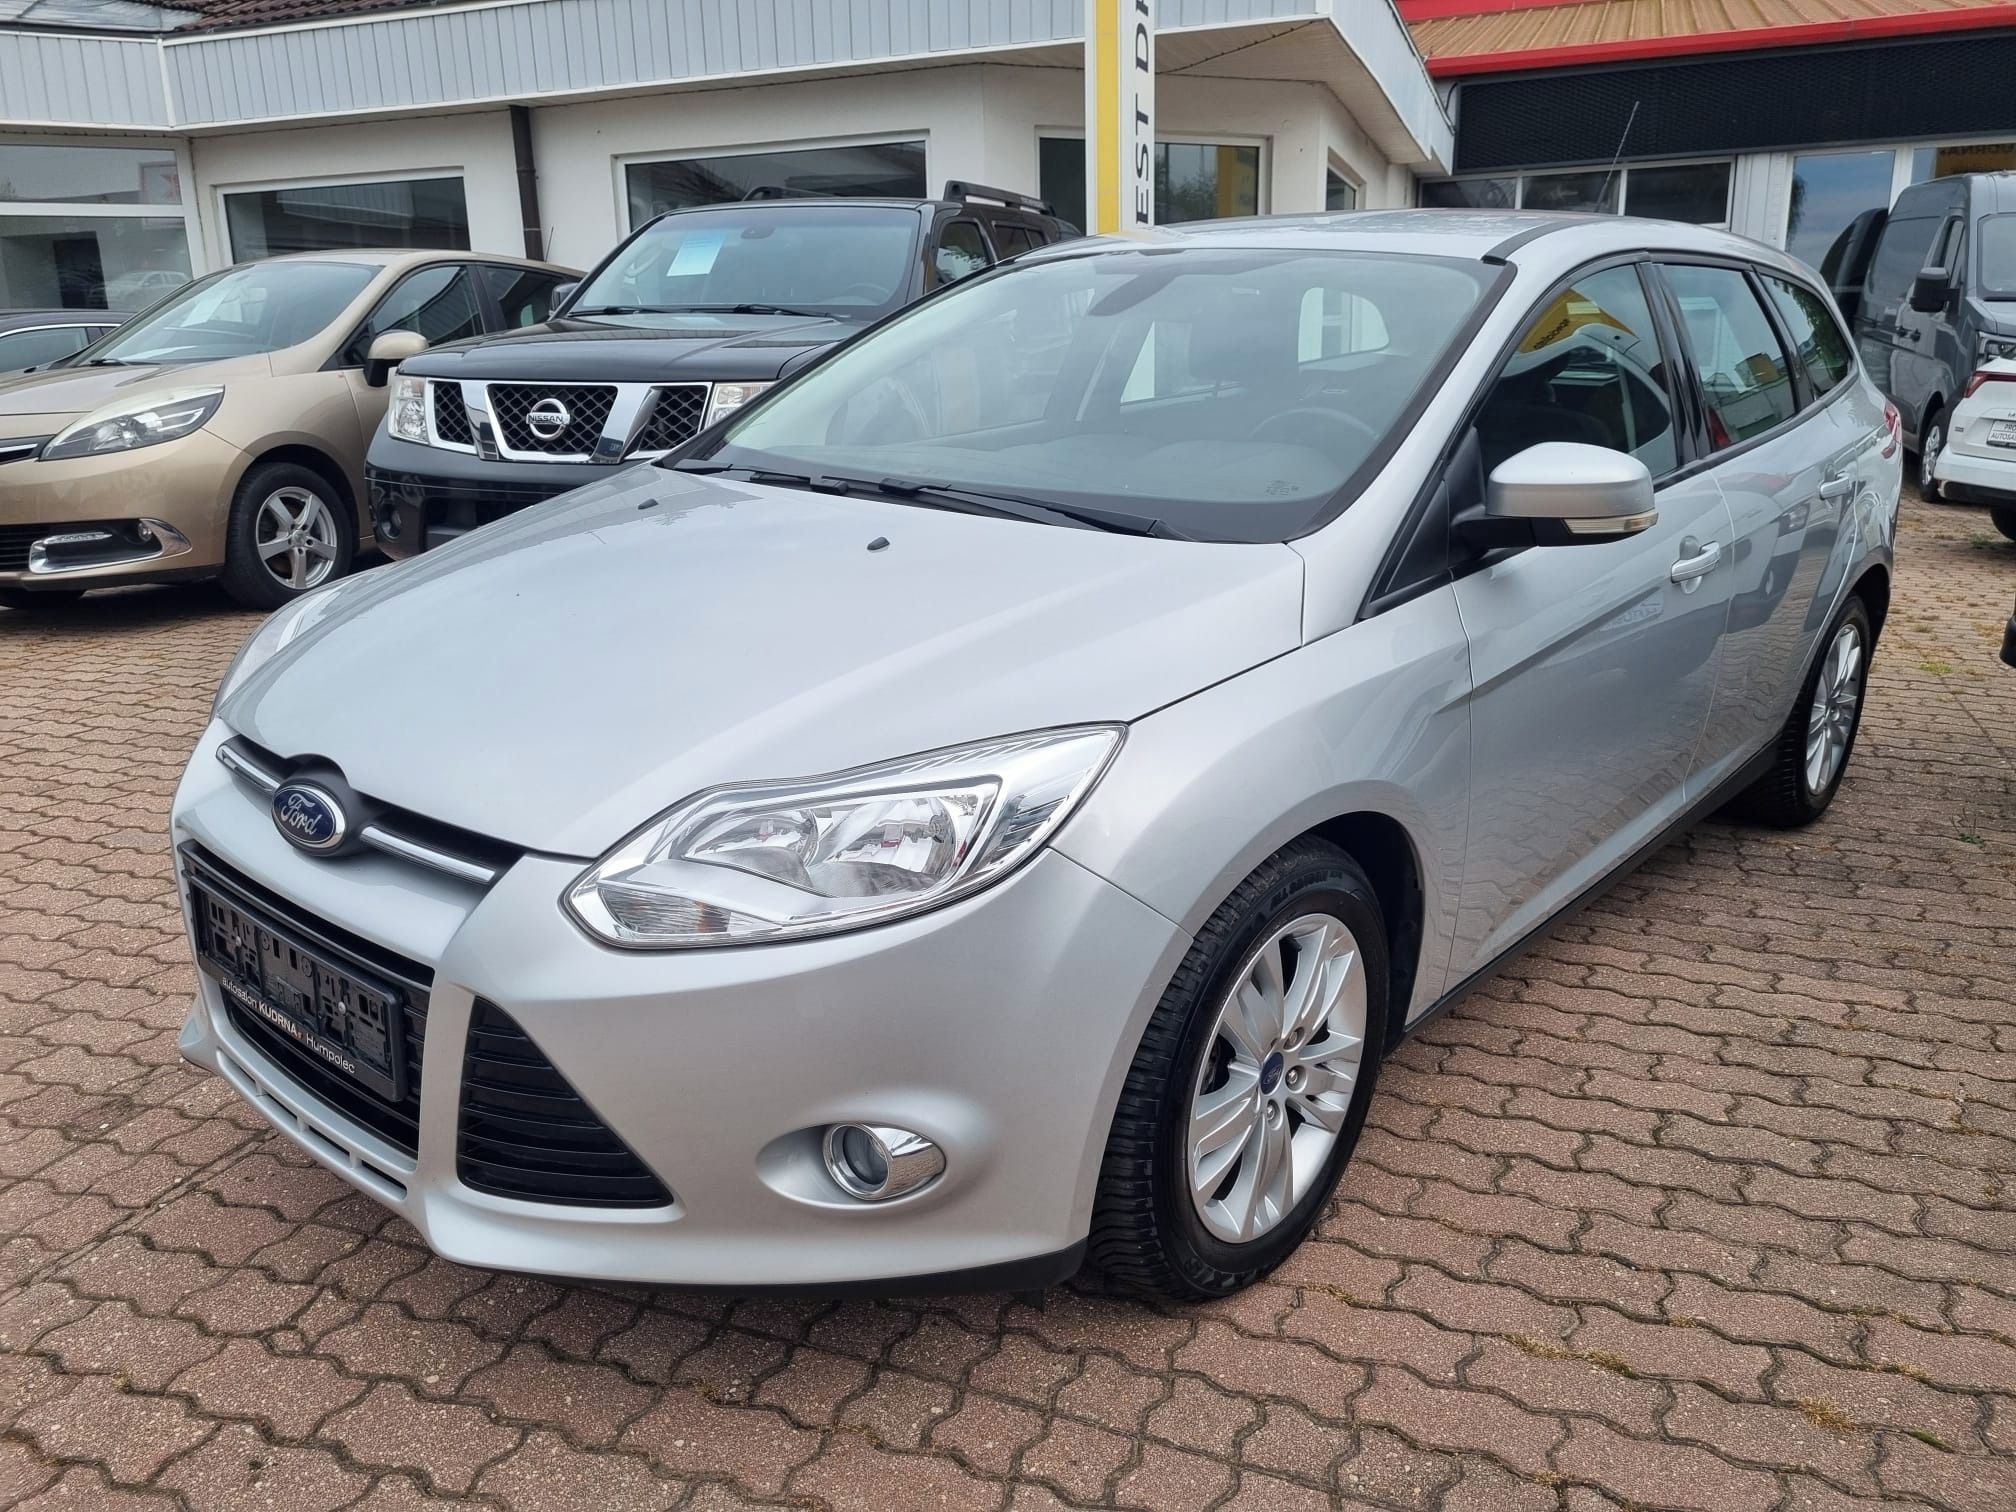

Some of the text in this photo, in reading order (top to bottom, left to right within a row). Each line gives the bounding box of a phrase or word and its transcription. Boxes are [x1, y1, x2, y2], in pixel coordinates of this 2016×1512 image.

[527, 414, 564, 423] NISSAN
[281, 793, 323, 835] Ford
[222, 977, 356, 1075] autosalon KUDRNA Humpolec
